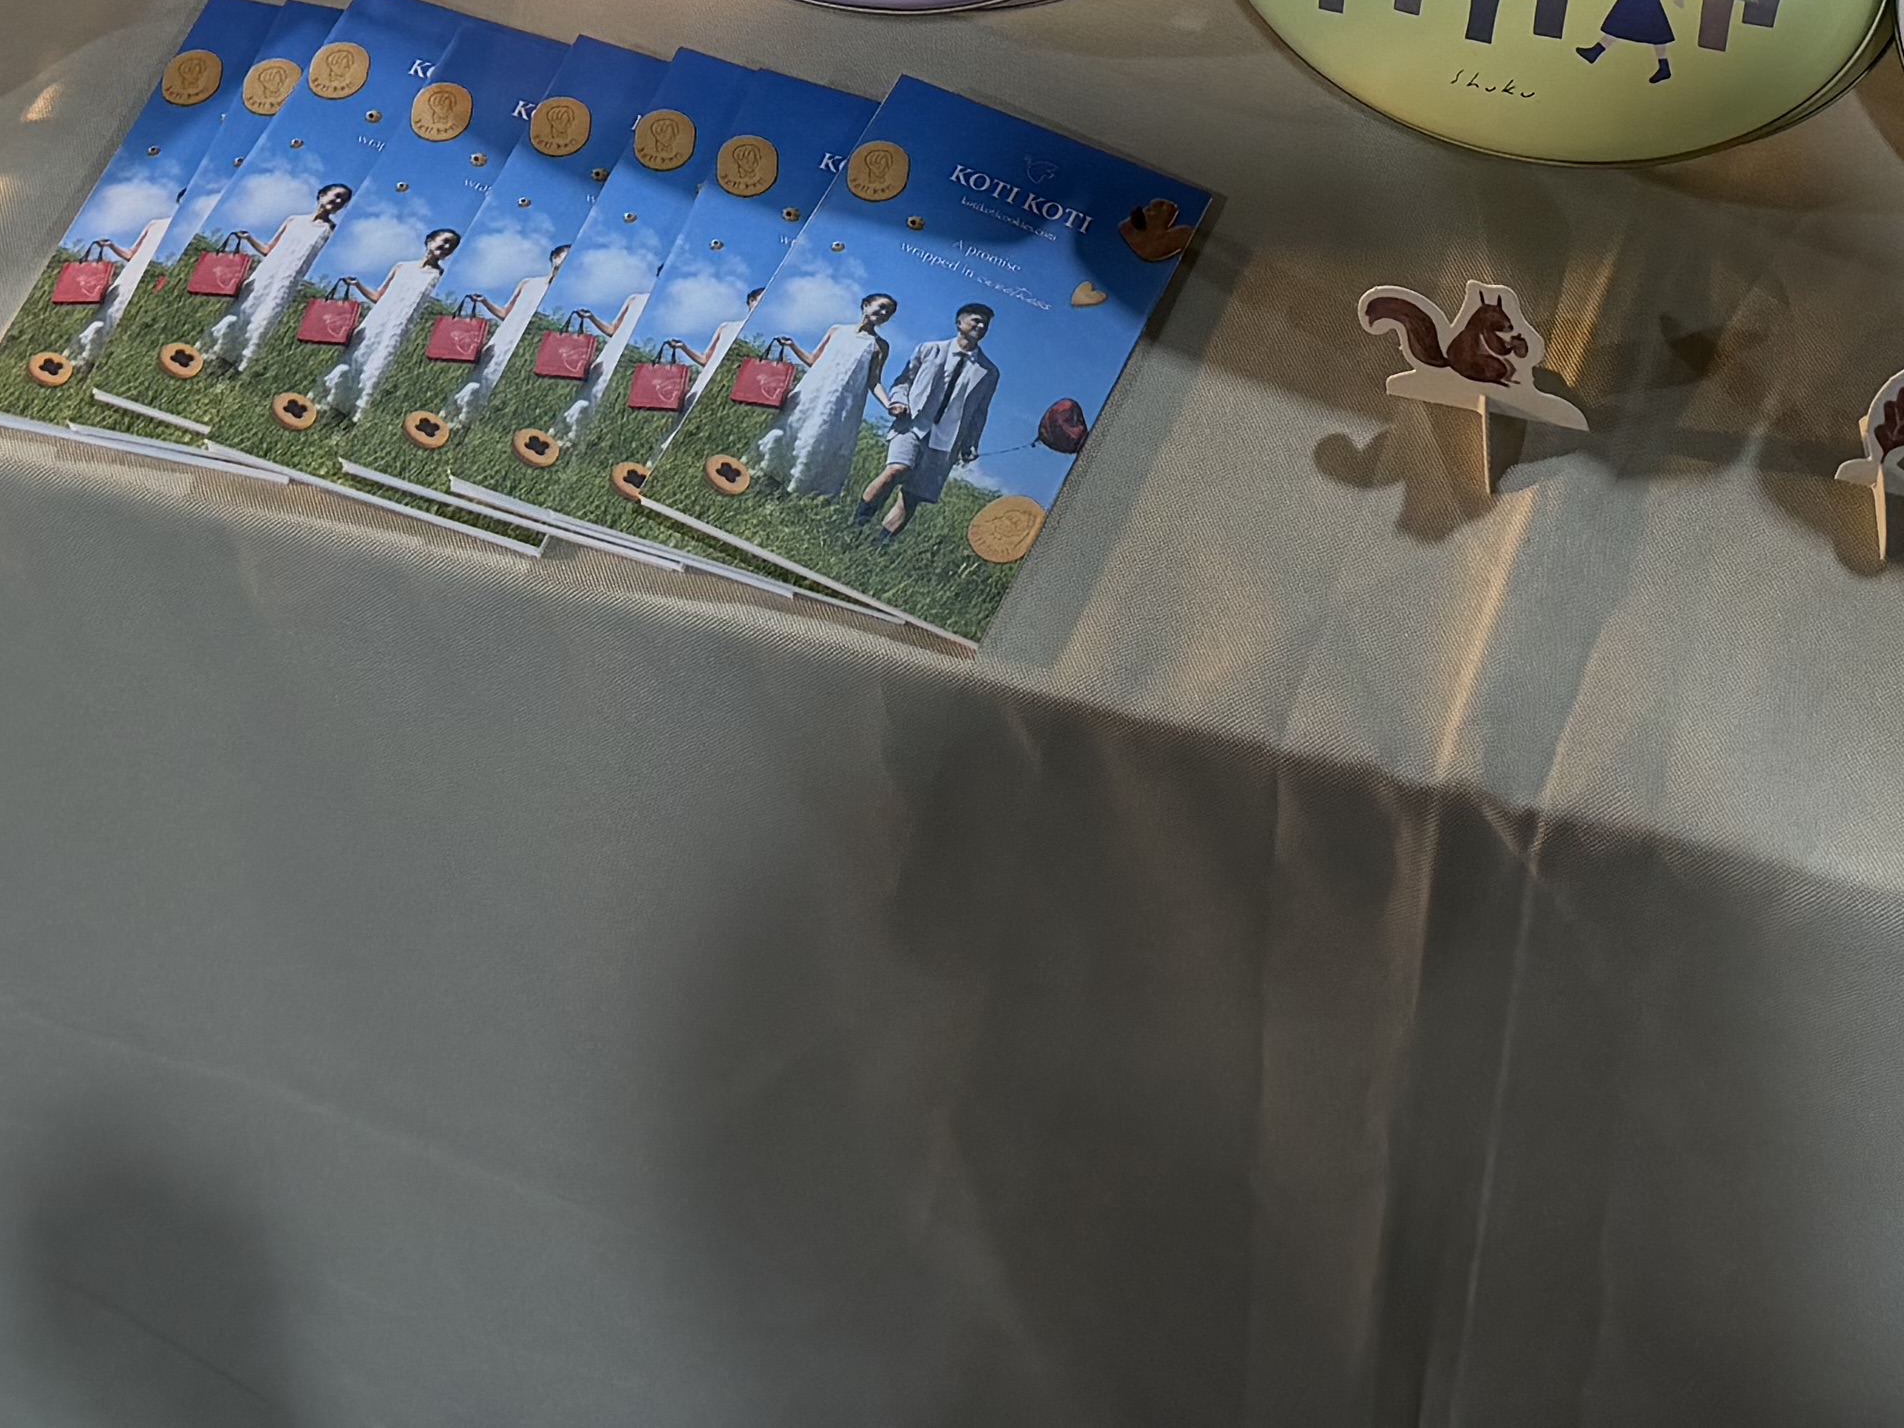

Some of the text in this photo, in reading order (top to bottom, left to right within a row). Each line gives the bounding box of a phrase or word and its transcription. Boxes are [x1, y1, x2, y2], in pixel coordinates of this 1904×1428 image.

[949, 164, 1095, 234] KOTI KOTI
[900, 241, 961, 272] wrapped
[962, 265, 975, 279] in
[953, 239, 1022, 274] A promise
